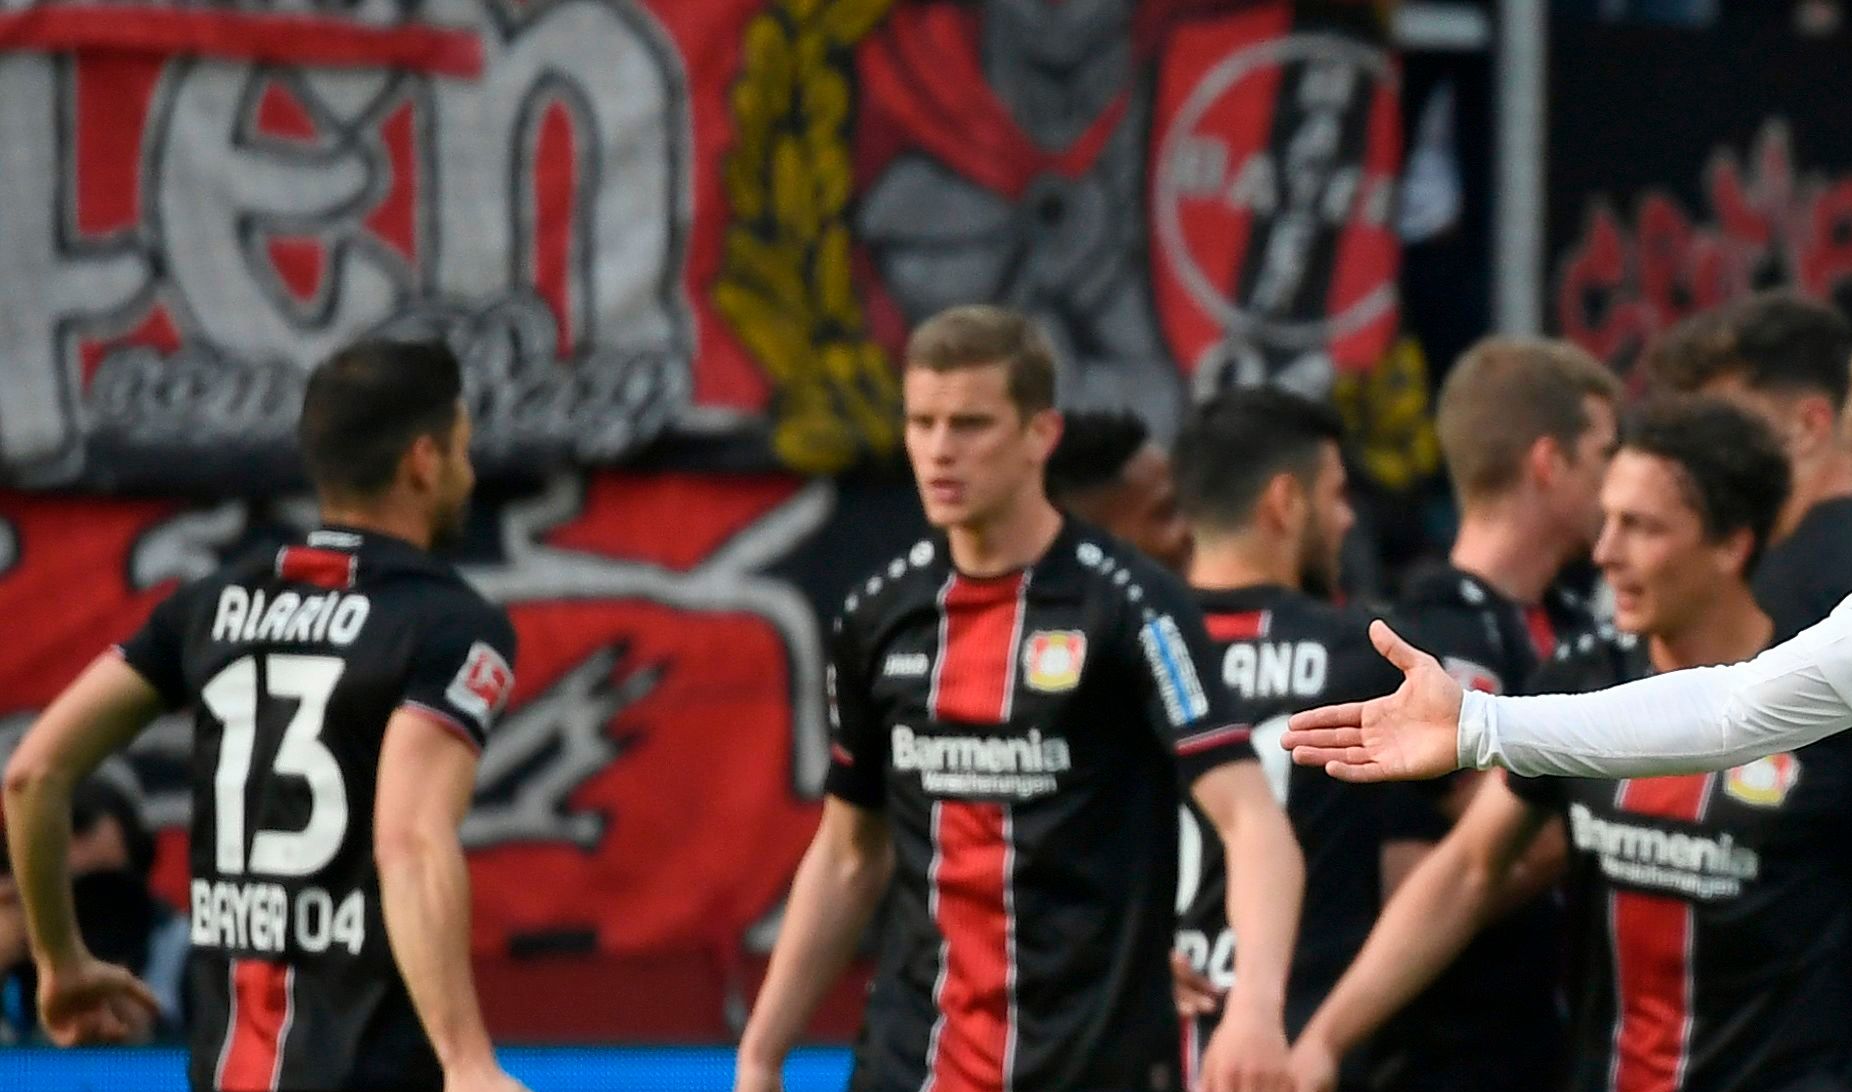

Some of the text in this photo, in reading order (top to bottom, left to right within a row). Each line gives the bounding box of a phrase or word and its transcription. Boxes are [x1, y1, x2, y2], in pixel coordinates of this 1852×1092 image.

[211, 585, 371, 647] ALARIO
[202, 653, 349, 877] 13
[891, 723, 1072, 773] Barmenia
[191, 878, 365, 955] BAYER 04
